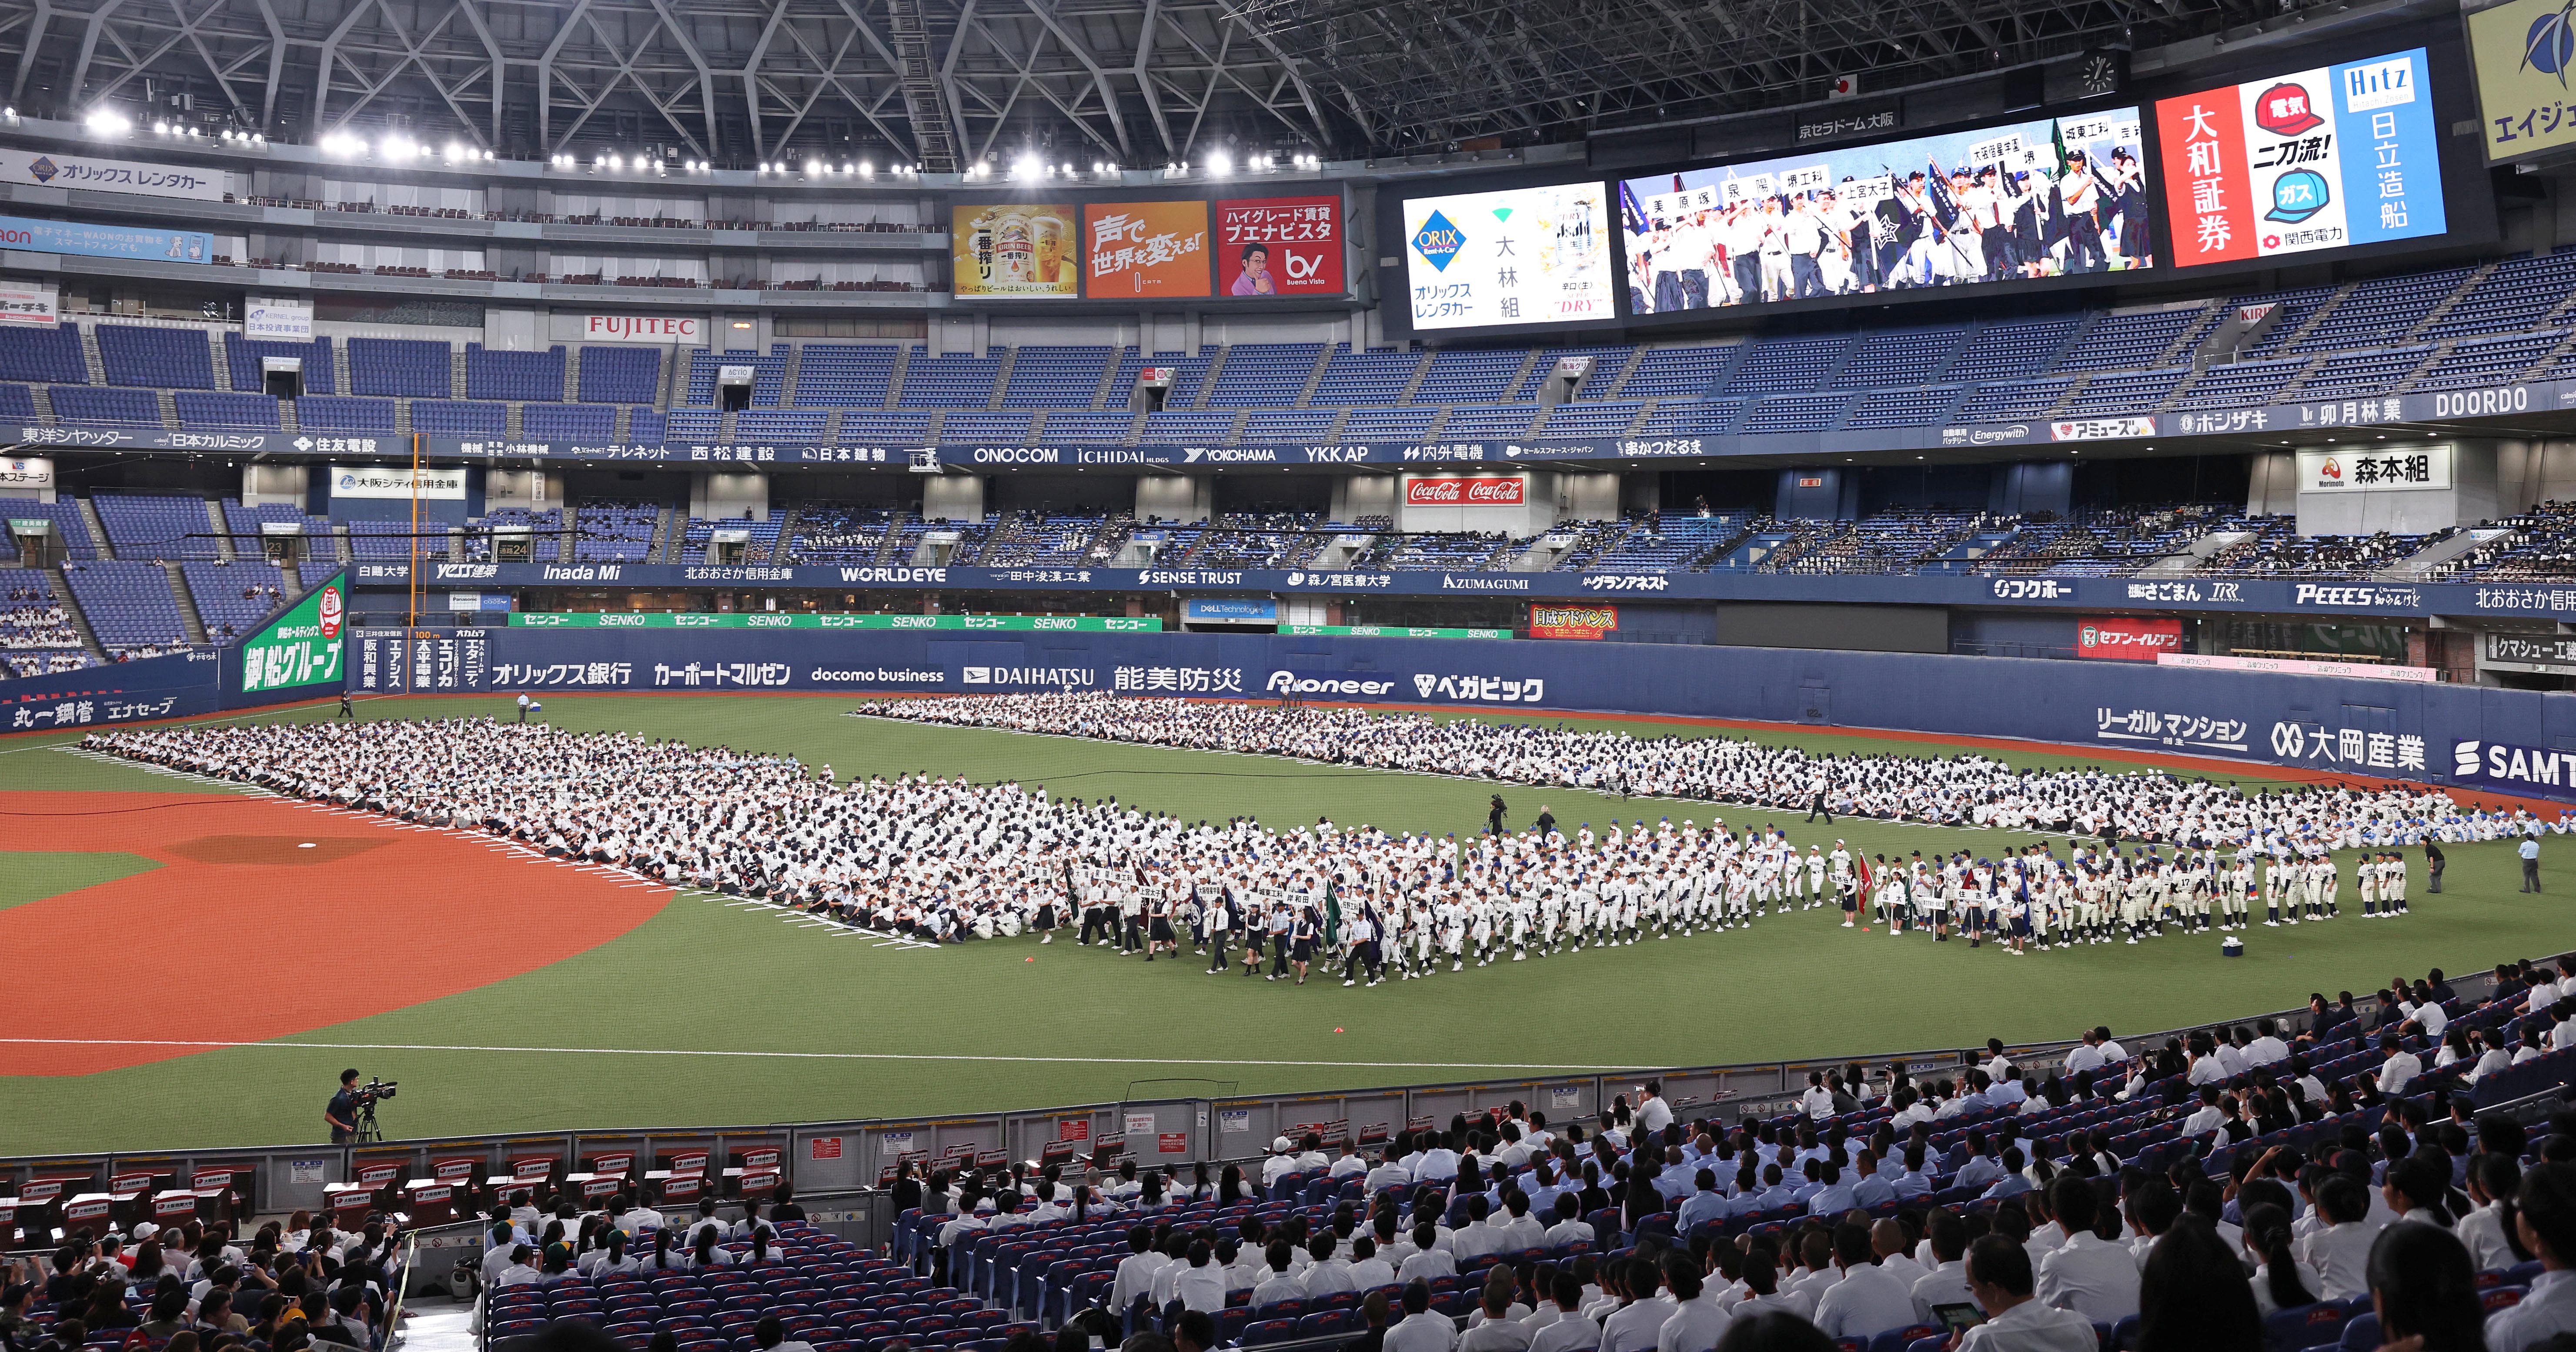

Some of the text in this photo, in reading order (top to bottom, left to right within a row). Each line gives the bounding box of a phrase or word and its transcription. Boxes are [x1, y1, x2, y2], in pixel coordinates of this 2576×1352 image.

[2350, 67, 2407, 96] Hitz
[2385, 92, 2409, 103] Zosen
[2269, 96, 2306, 118] 電気
[1799, 111, 1894, 139] 京セラドーム 大阪
[2066, 121, 2109, 140] 城東工科
[2024, 150, 2035, 165] 堺
[2253, 134, 2332, 169] 二刀流!
[63, 164, 132, 184] オリックス
[138, 170, 206, 189] レンタカー
[1787, 170, 1823, 188] 堺工科
[2182, 104, 2232, 253] 大和証券
[2372, 111, 2408, 230] 日立造船
[1728, 177, 1769, 198] 泉陽
[1848, 180, 1890, 200] 上宮太子
[2279, 184, 2313, 205] ガス
[1226, 207, 1331, 224] ハイグレード賃貸
[1093, 213, 1146, 253] 声で
[1226, 221, 1332, 243] ブエナビスタ
[1418, 228, 1458, 247] ORIX
[1557, 220, 1589, 239] Asahi
[2284, 226, 2342, 247] 関西電力
[55, 237, 138, 252] スマートフォンでも
[998, 242, 1032, 251] KIRIN BEER
[1423, 247, 1456, 255] Rent-A-Car
[978, 229, 992, 280] 一番搾り
[1001, 252, 1028, 260] 一番搾り
[1092, 231, 1205, 277] 世界を変える!
[1495, 235, 1520, 318] 大林組
[1415, 283, 1472, 300] オリックス
[1416, 302, 1473, 318] レンタカー
[249, 323, 309, 333] 日本投資事業団
[590, 317, 695, 339] FUJITEC
[2436, 387, 2527, 417] DOORDO
[2320, 398, 2401, 425] 卯月林業
[2077, 420, 2135, 439] アミューズ
[2196, 410, 2268, 433] ホシザキ
[21, 427, 133, 445] 東洋シャッター
[173, 433, 264, 449] 日本カルミック
[1942, 428, 1967, 437] 自動車用
[1975, 428, 2025, 441] Energywith
[316, 437, 377, 453] 住友電設
[505, 443, 549, 455] 小林機械
[607, 445, 670, 460] テレネット
[691, 446, 775, 461] 西松建設
[1305, 446, 1368, 462] YKK AP
[1422, 444, 1483, 461] 内外電機
[1523, 445, 1594, 454] セールスフォース・ジャパン
[1625, 440, 1702, 456] 串かつだるま
[820, 447, 886, 462] 日本建物
[974, 448, 1058, 463] ONOCOM
[1077, 448, 1144, 464] ICHIDAI
[1206, 449, 1276, 462] YOKOHAMA
[2355, 454, 2429, 484] 森本組
[357, 477, 458, 490] 大阪シティ信用金庫
[1410, 481, 1522, 501] Coca-Cola Coca-Cola
[267, 542, 282, 552] 23
[543, 564, 621, 580] Inada Mi
[684, 567, 793, 581] 北おおさか信用金庫
[1152, 571, 1242, 584] SENSE TRUST
[1308, 573, 1391, 588] 森ノ宮医療大学
[1443, 573, 1529, 590] AZUMAGUMI
[1592, 574, 1669, 591] グランアネスト
[2010, 580, 2072, 598] フクホー
[2295, 584, 2376, 606] PEEES
[1221, 605, 1263, 614] Technologies
[1534, 608, 1615, 627] 日成アドバンス
[523, 614, 1148, 630] センコー SENKO センコー SENKO センコー SENKO センコー SENKO センコー
[415, 631, 431, 639] 100
[1292, 625, 1499, 639] センコー SENKO センコー SENKO
[244, 639, 342, 691] 御船グループ
[363, 639, 377, 688] 阪和興業
[388, 640, 401, 688] エアシス
[438, 639, 454, 688] エコリカ
[464, 639, 479, 688] エタニティ
[492, 662, 632, 685] オリックス銀行
[655, 661, 791, 686] カーポートマルゼン
[811, 667, 944, 682] docomo business
[994, 668, 1095, 686] DAIHATSU
[1114, 666, 1243, 693] 能美防災
[1437, 674, 1544, 702] ベガビック
[13, 700, 94, 728] 丸一鋼管
[107, 698, 174, 719] エナセーブ
[2097, 708, 2248, 742] リーガルマンション
[2309, 726, 2425, 772] 大岡産業
[1259, 888, 1283, 899] 城東工科
[1287, 895, 1309, 904] 岸和田
[1883, 893, 1902, 902] 信太
[1959, 890, 1982, 899] 住吉
